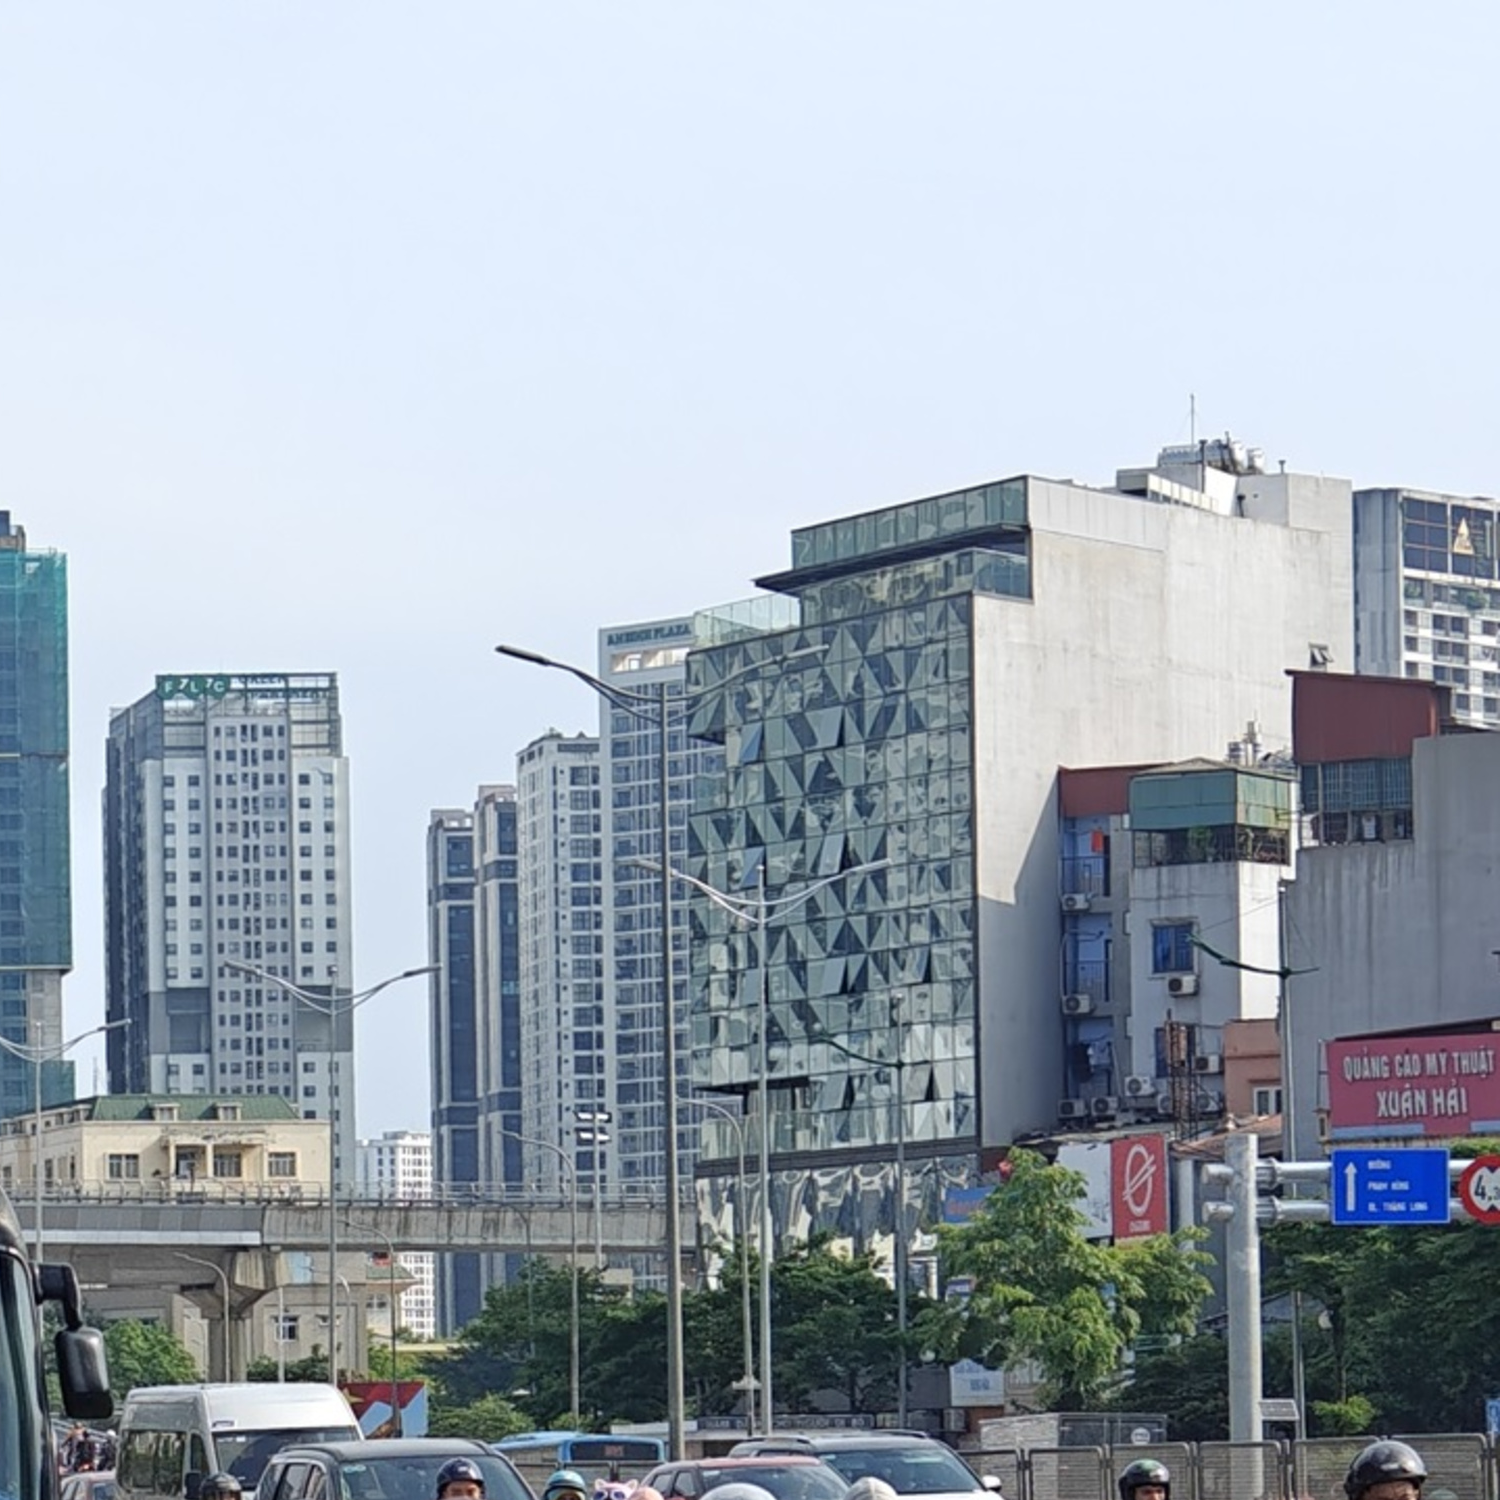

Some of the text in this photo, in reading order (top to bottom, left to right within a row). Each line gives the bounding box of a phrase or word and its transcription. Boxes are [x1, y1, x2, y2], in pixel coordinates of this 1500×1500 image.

[1343, 1046, 1390, 1082] QUẢNG
[1452, 1045, 1495, 1078] THUẬT
[1376, 1078, 1468, 1118] XUÂN HẢI
